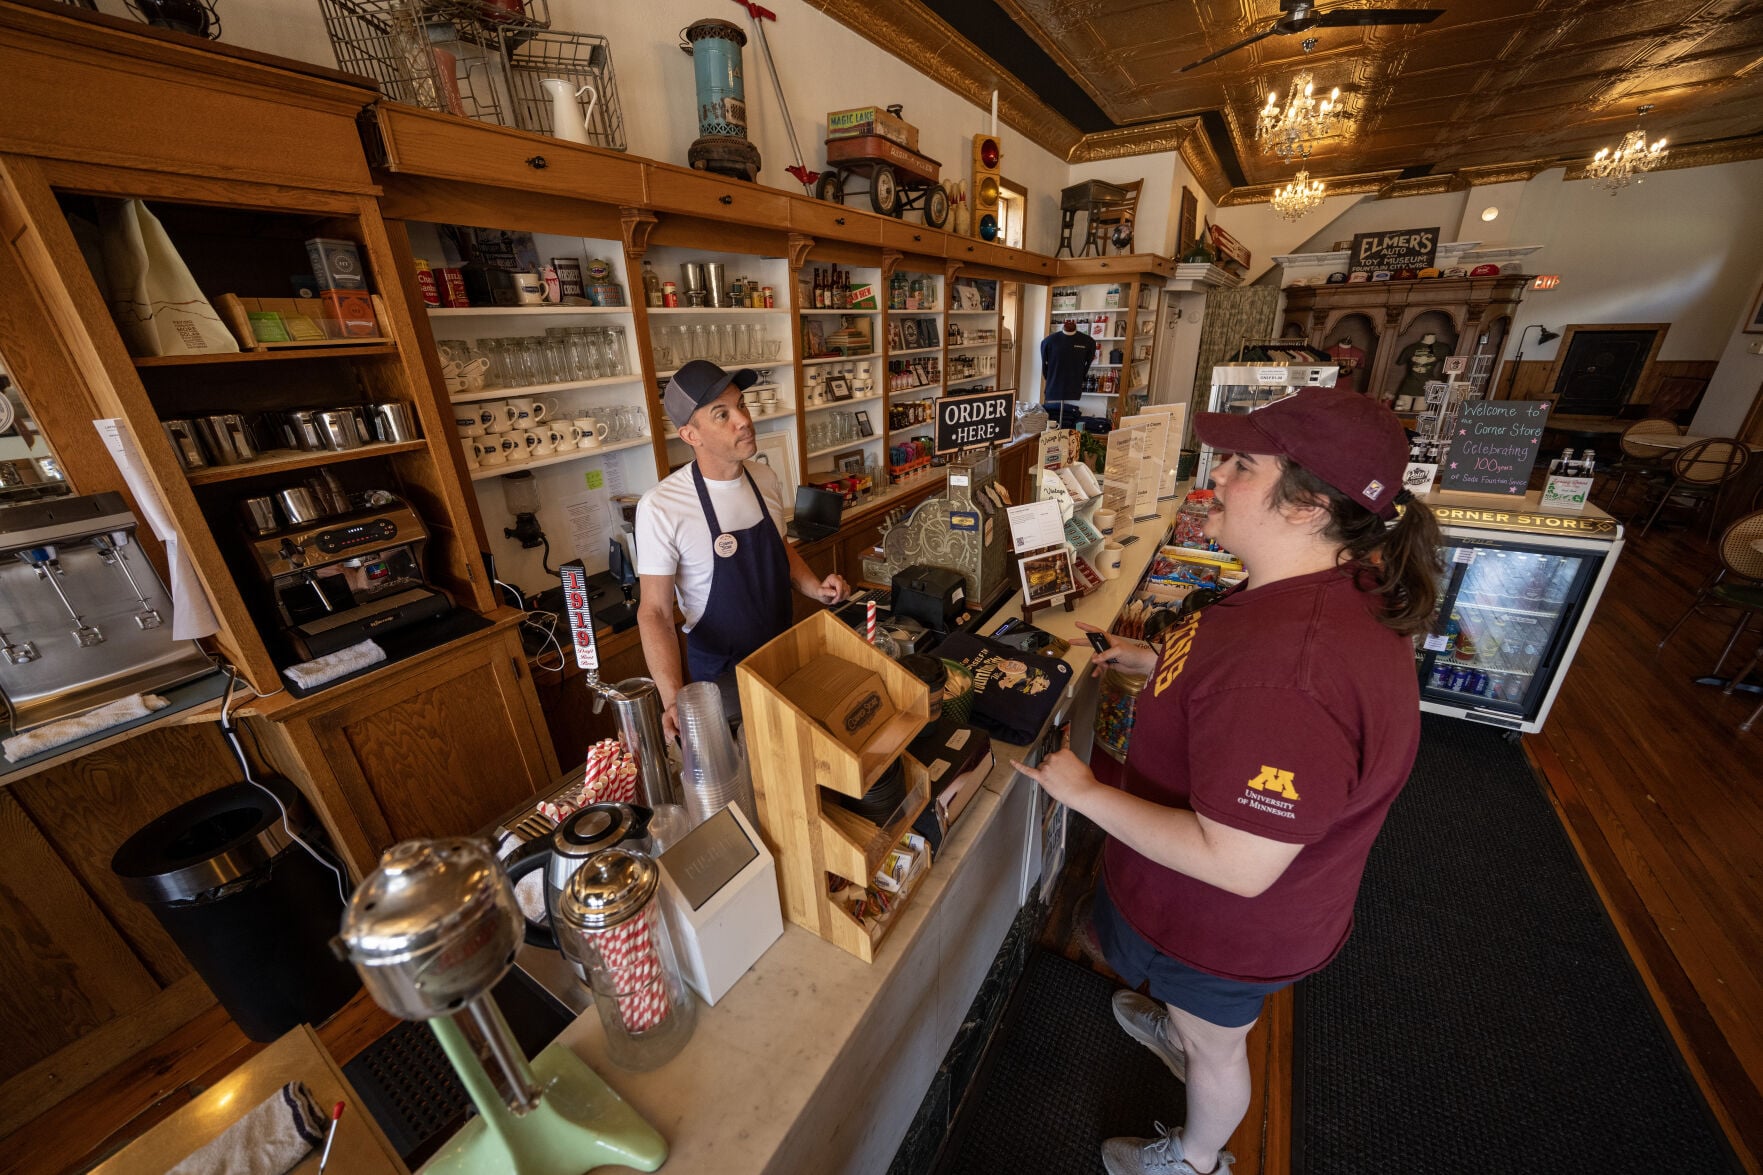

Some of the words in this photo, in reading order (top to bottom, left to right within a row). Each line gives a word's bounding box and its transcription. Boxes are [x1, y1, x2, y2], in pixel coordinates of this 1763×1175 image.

[830, 114, 853, 126] MAGIC
[856, 110, 874, 122] LAKE
[1360, 231, 1433, 260] ELMER'S
[1381, 247, 1407, 255] AUTO
[1384, 255, 1427, 265] MUSEUM
[1352, 264, 1388, 273] FOUNTAIN
[1533, 275, 1556, 289] EXIT
[945, 399, 1007, 425] ORDER
[1464, 402, 1517, 416] Welcome
[1526, 405, 1540, 417] to
[957, 423, 995, 443] HERE
[1474, 422, 1508, 436] Corner
[1510, 422, 1541, 437] Store
[1463, 441, 1528, 462] Celebrating
[1474, 458, 1498, 472] 100
[1431, 507, 1510, 523] ORNER
[1518, 514, 1593, 530] STORE
[1237, 796, 1249, 805] OF
